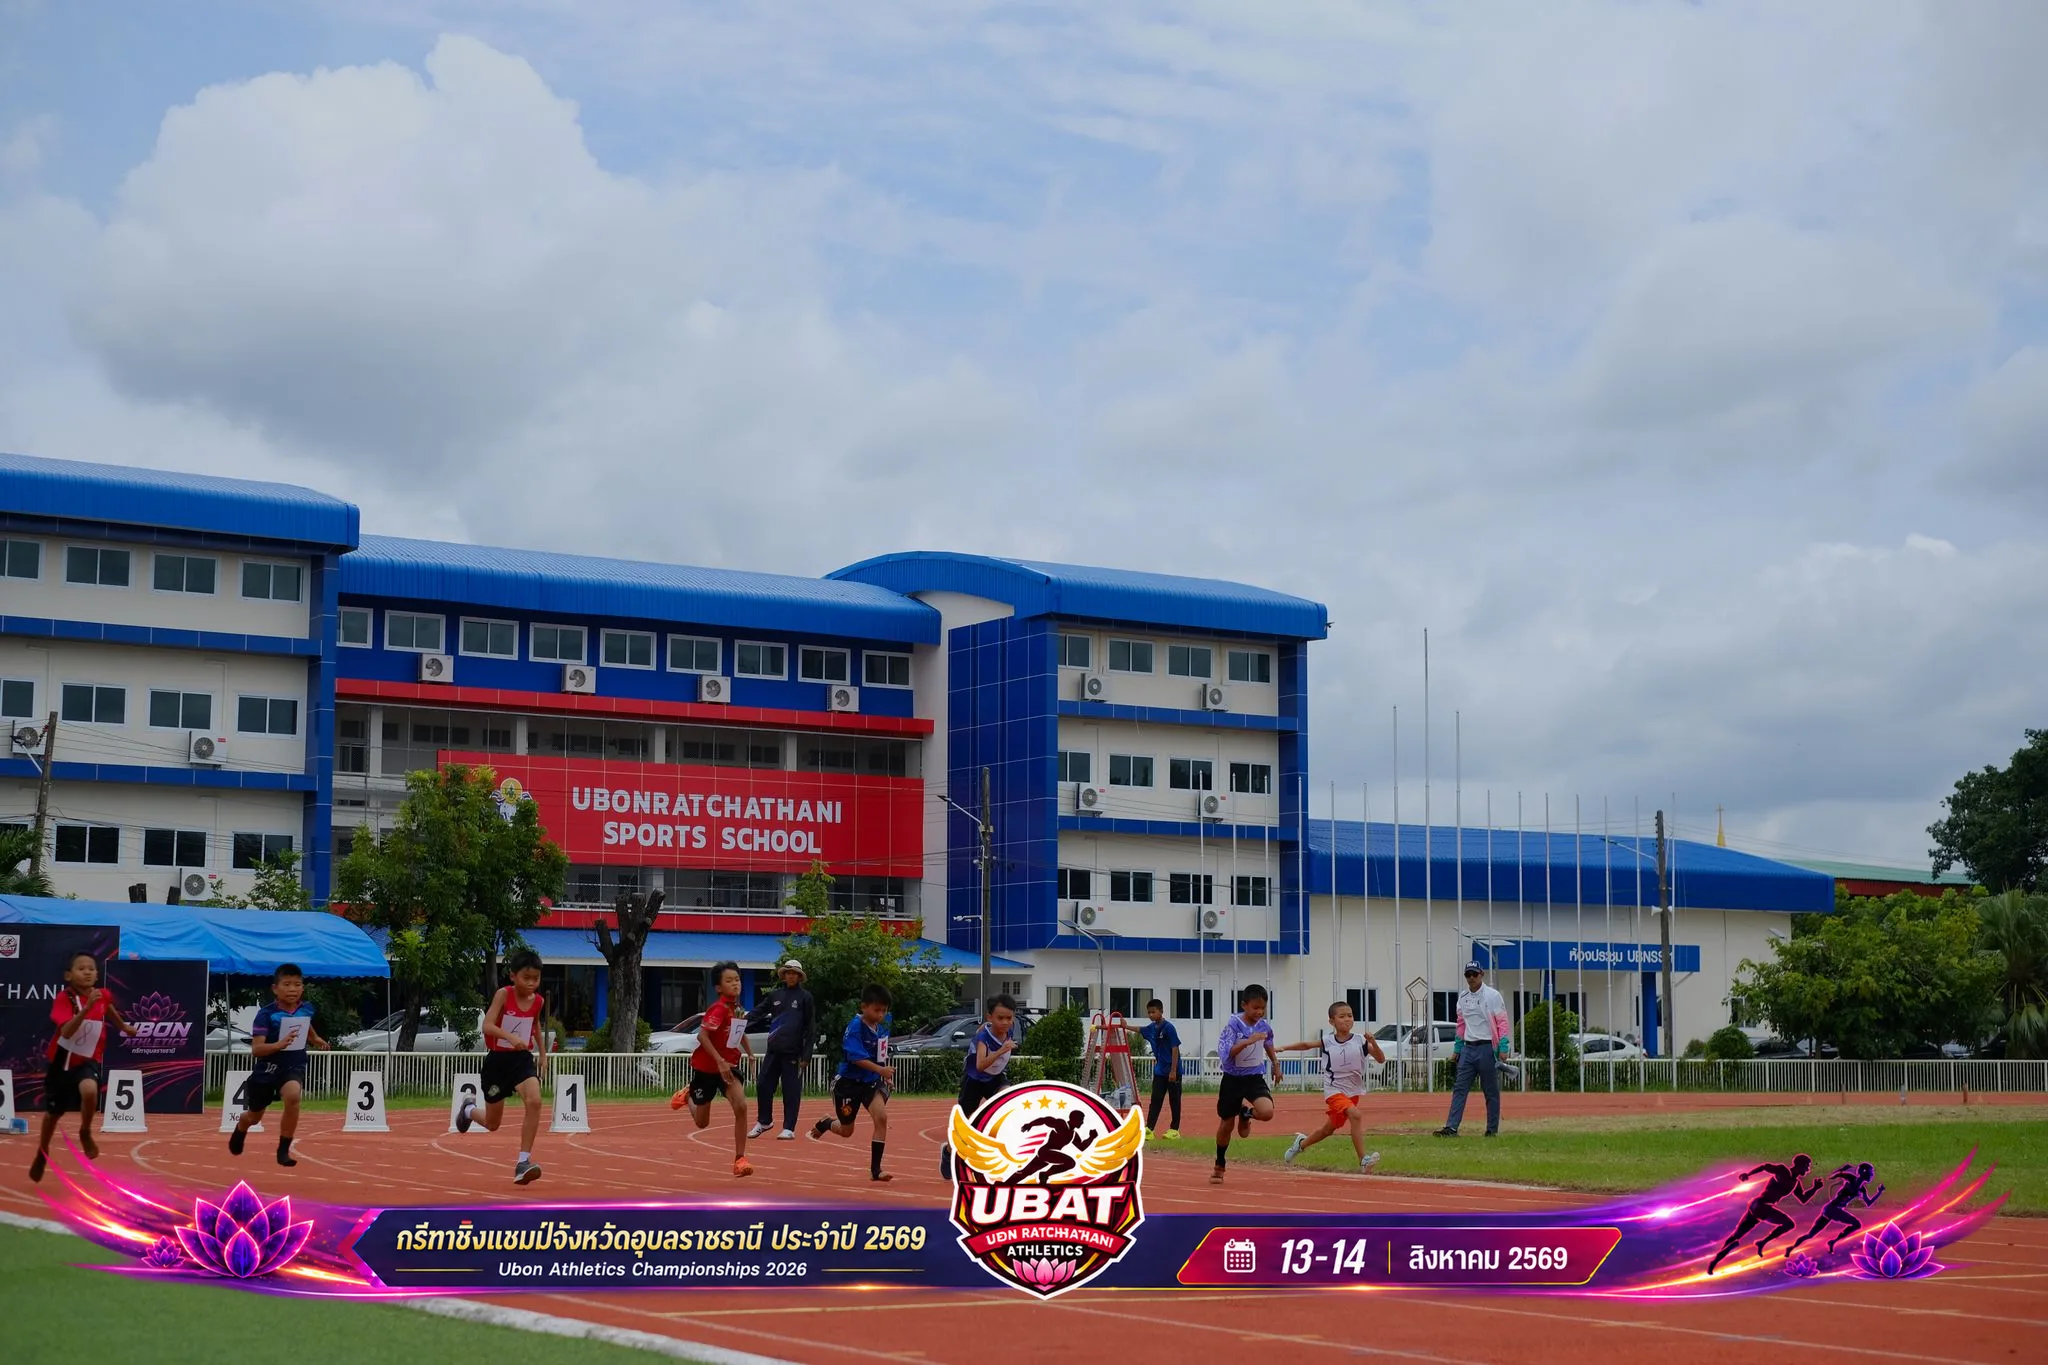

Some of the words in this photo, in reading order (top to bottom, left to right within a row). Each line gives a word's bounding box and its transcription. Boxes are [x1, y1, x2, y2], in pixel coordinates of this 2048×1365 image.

[572, 786, 842, 824] UBONRATCHATHANI
[603, 821, 707, 849] SPORTS
[721, 826, 822, 854] SCHOOL
[122, 1037, 188, 1047] ATHLETICS
[1338, 1048, 1352, 1067] 1
[115, 1079, 135, 1111] 5
[232, 1080, 250, 1111] 4
[357, 1080, 375, 1111] 3
[565, 1082, 578, 1112] 1
